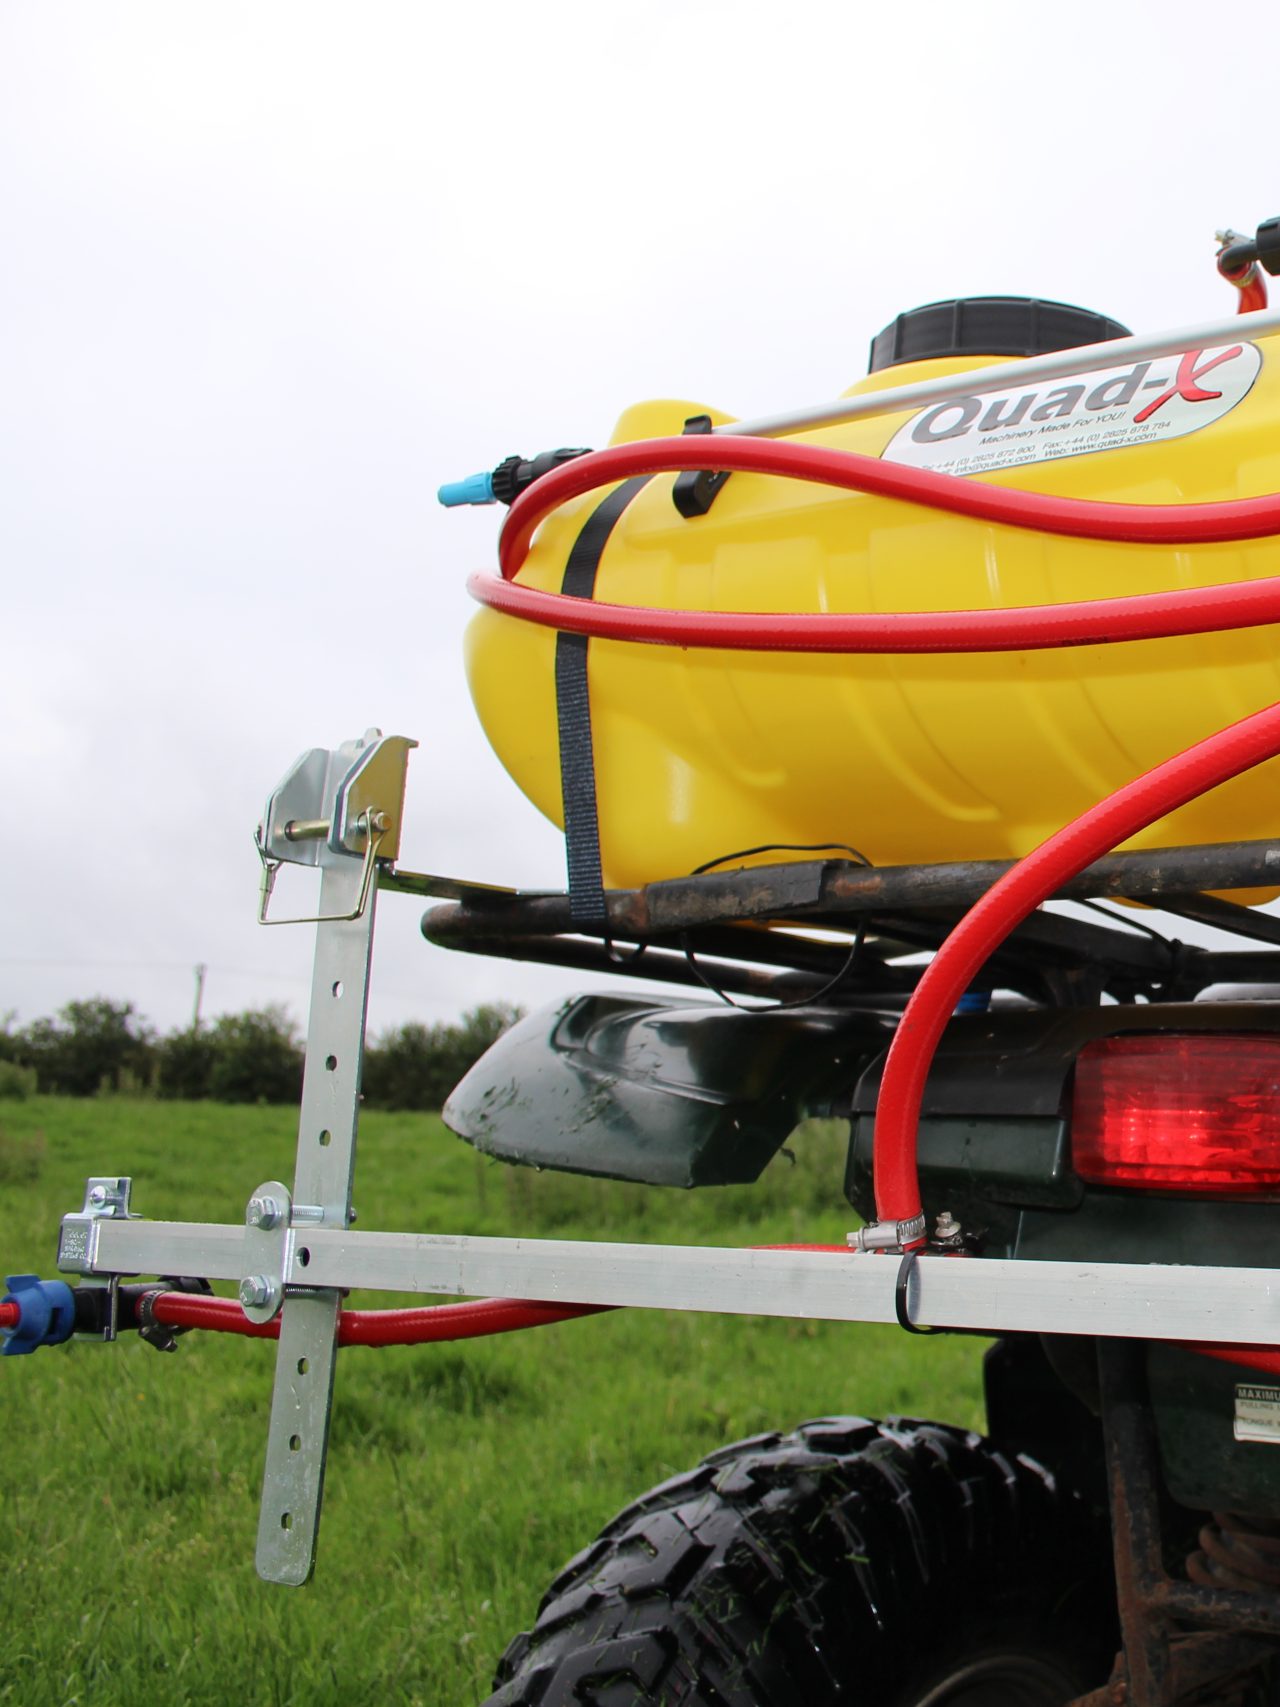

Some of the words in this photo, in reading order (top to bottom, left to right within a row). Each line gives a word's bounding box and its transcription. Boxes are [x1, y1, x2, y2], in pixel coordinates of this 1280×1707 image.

[979, 427, 1034, 446] Machinery
[1038, 421, 1070, 434] Made
[1073, 418, 1093, 428] For
[1065, 435, 1084, 445] +44
[1087, 432, 1101, 443] (0)
[1072, 432, 1157, 453] www.quad-x.com
